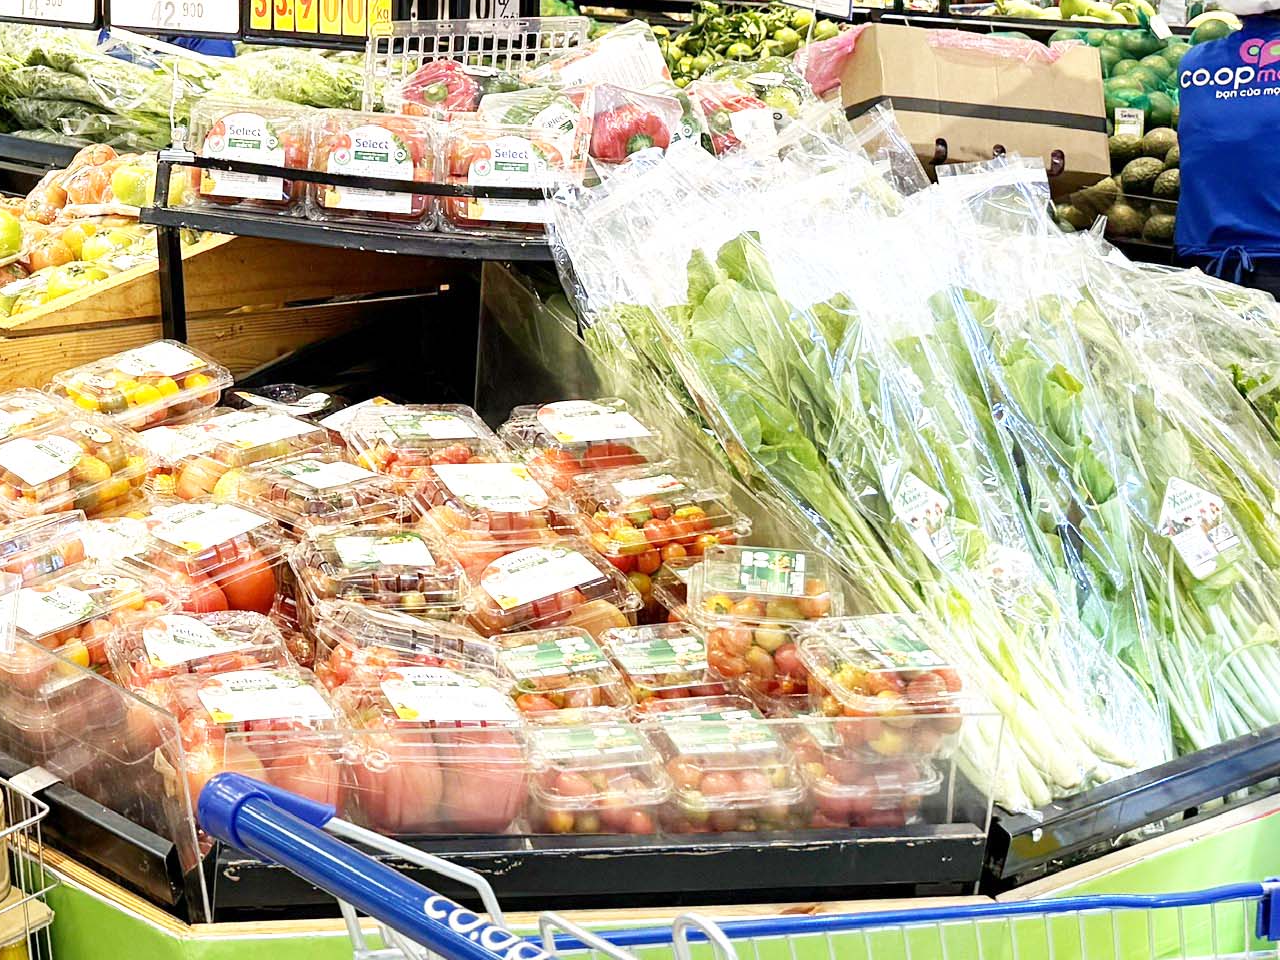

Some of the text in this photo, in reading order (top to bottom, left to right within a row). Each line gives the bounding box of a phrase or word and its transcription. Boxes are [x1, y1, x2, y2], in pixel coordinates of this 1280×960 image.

[1215, 90, 1237, 99] bạn
[1239, 87, 1261, 97] của
[229, 125, 262, 138] Select
[355, 138, 389, 150] Select
[494, 147, 529, 160] Select
